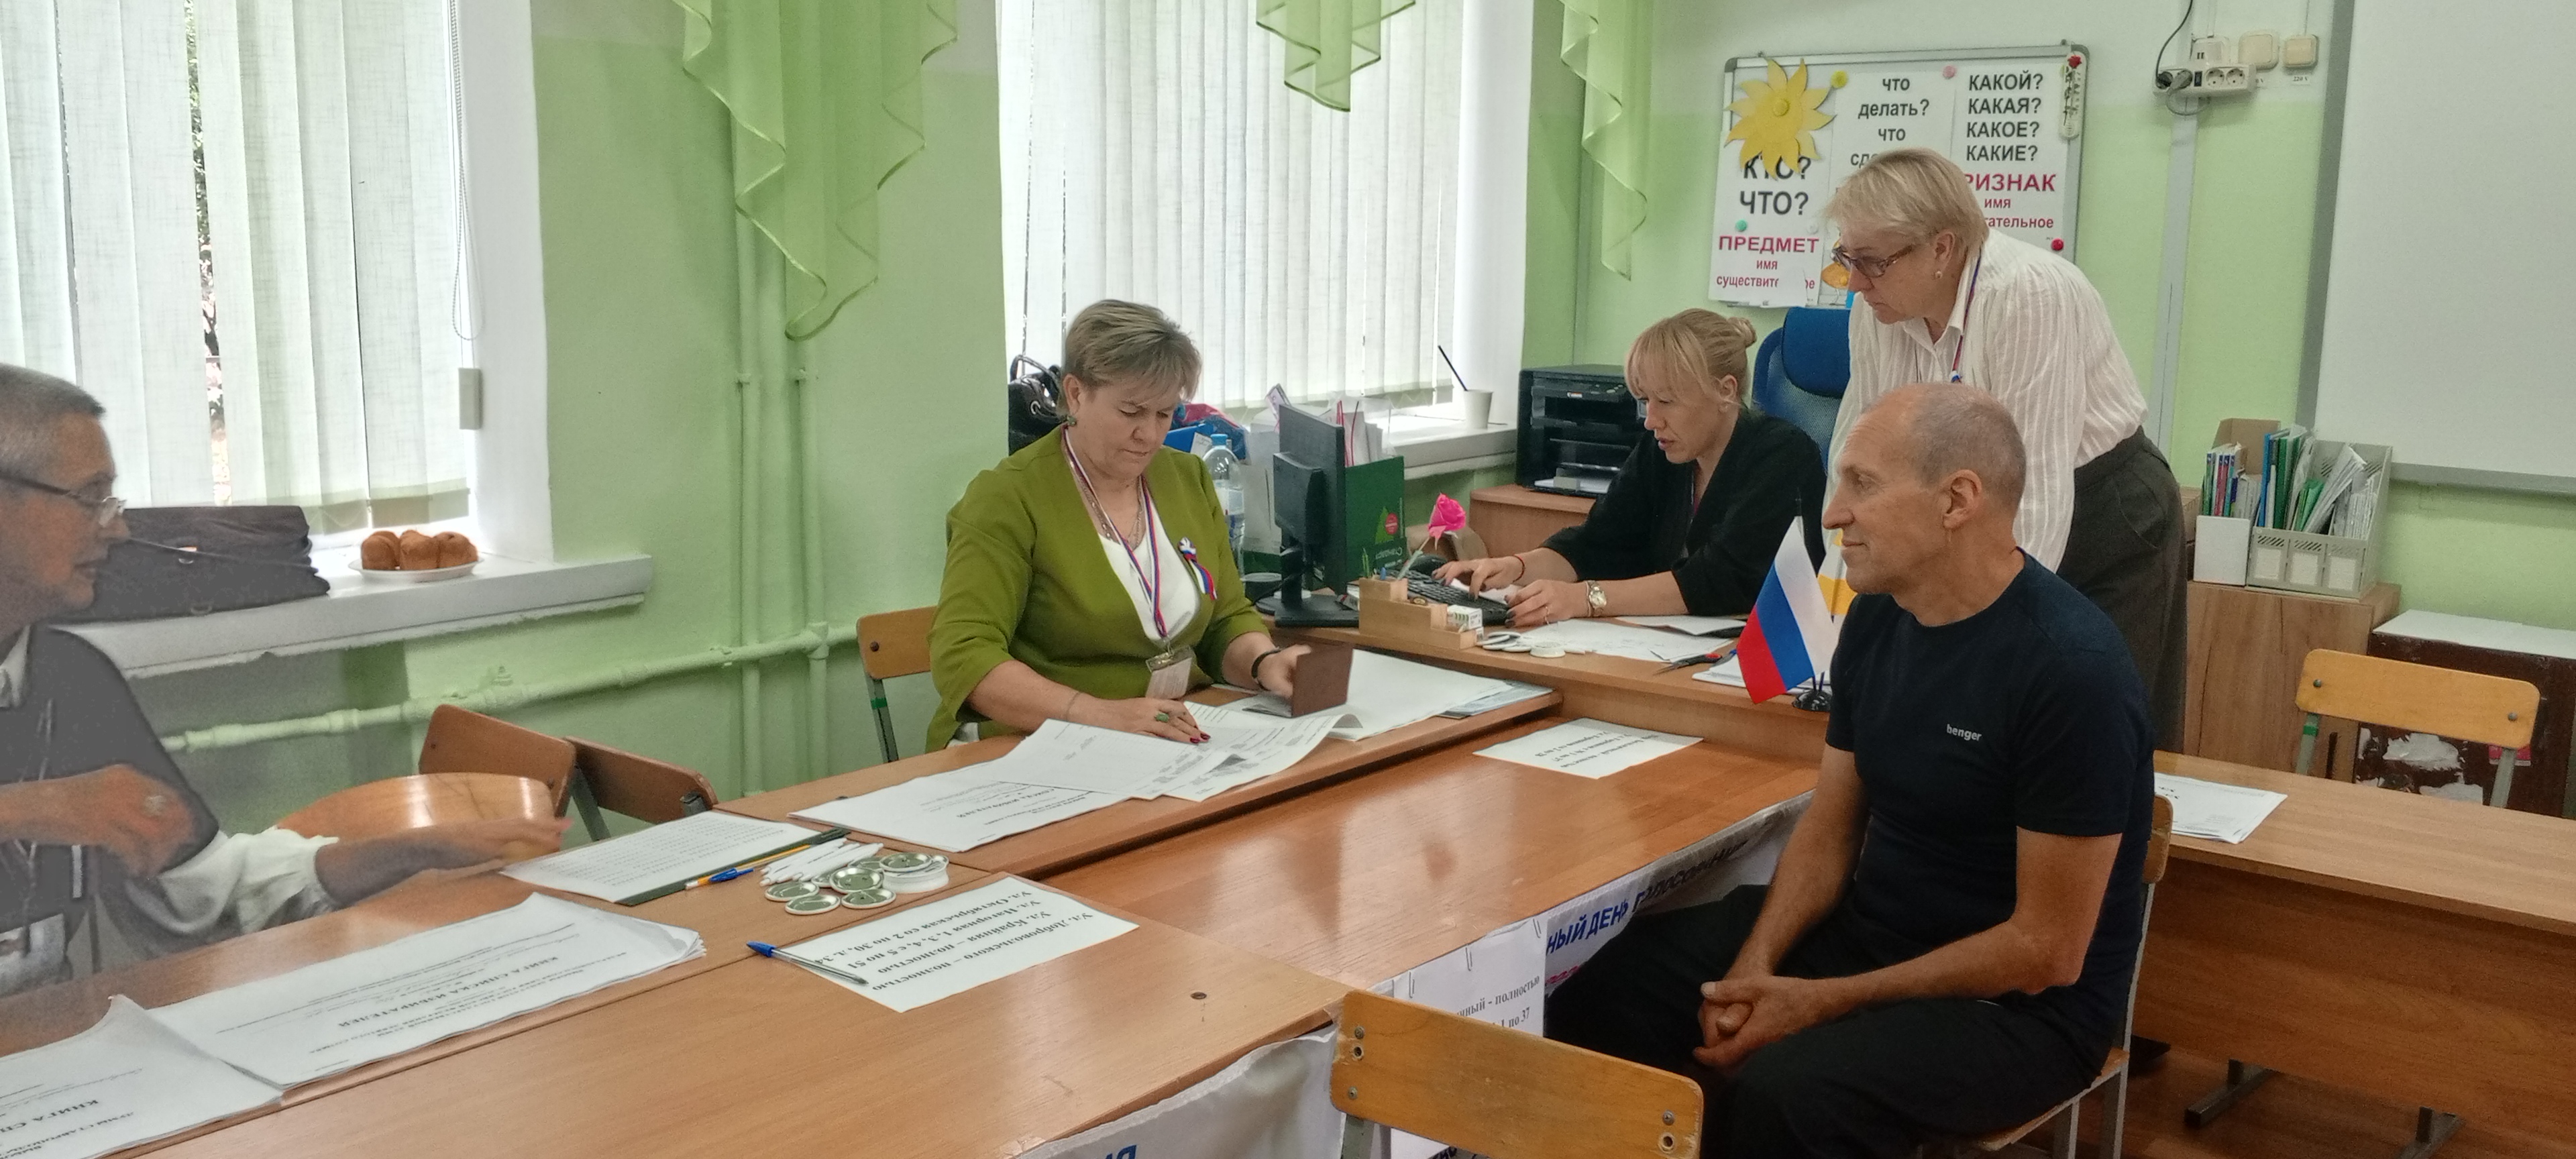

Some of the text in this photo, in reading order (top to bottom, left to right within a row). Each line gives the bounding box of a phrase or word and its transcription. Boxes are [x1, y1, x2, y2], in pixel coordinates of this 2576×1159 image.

[1882, 78, 1911, 91] что
[1969, 70, 2043, 91] КАКОЙ?
[1858, 99, 1929, 119] делать?
[1968, 97, 2041, 114] КАКАЯ?
[1878, 128, 1906, 141] что
[1966, 121, 2040, 138] КАКОЕ?
[1966, 145, 2038, 161] КАКИЕ?
[1739, 190, 1809, 215] ЧТО?
[1984, 199, 2011, 209] имя
[1985, 217, 2054, 228] ательное
[1719, 235, 1819, 254] ПРЕДМЕТ
[1756, 260, 1778, 270] имя
[1947, 724, 1982, 741] benger
[921, 898, 1009, 930] Октябрьская
[953, 908, 1018, 932] Нагорная
[1585, 898, 1629, 940] ДЕНЬ
[964, 920, 1069, 960] Добровольского
[967, 919, 1028, 942] Крайняя
[847, 960, 866, 969] 51
[867, 952, 885, 961] по
[877, 944, 955, 973] полностью
[872, 962, 951, 991] полностью
[1495, 975, 1540, 1005] полностью
[1509, 1016, 1519, 1028] по
[1521, 1007, 1530, 1022] 37
[32, 1100, 99, 1122] КНИГА
